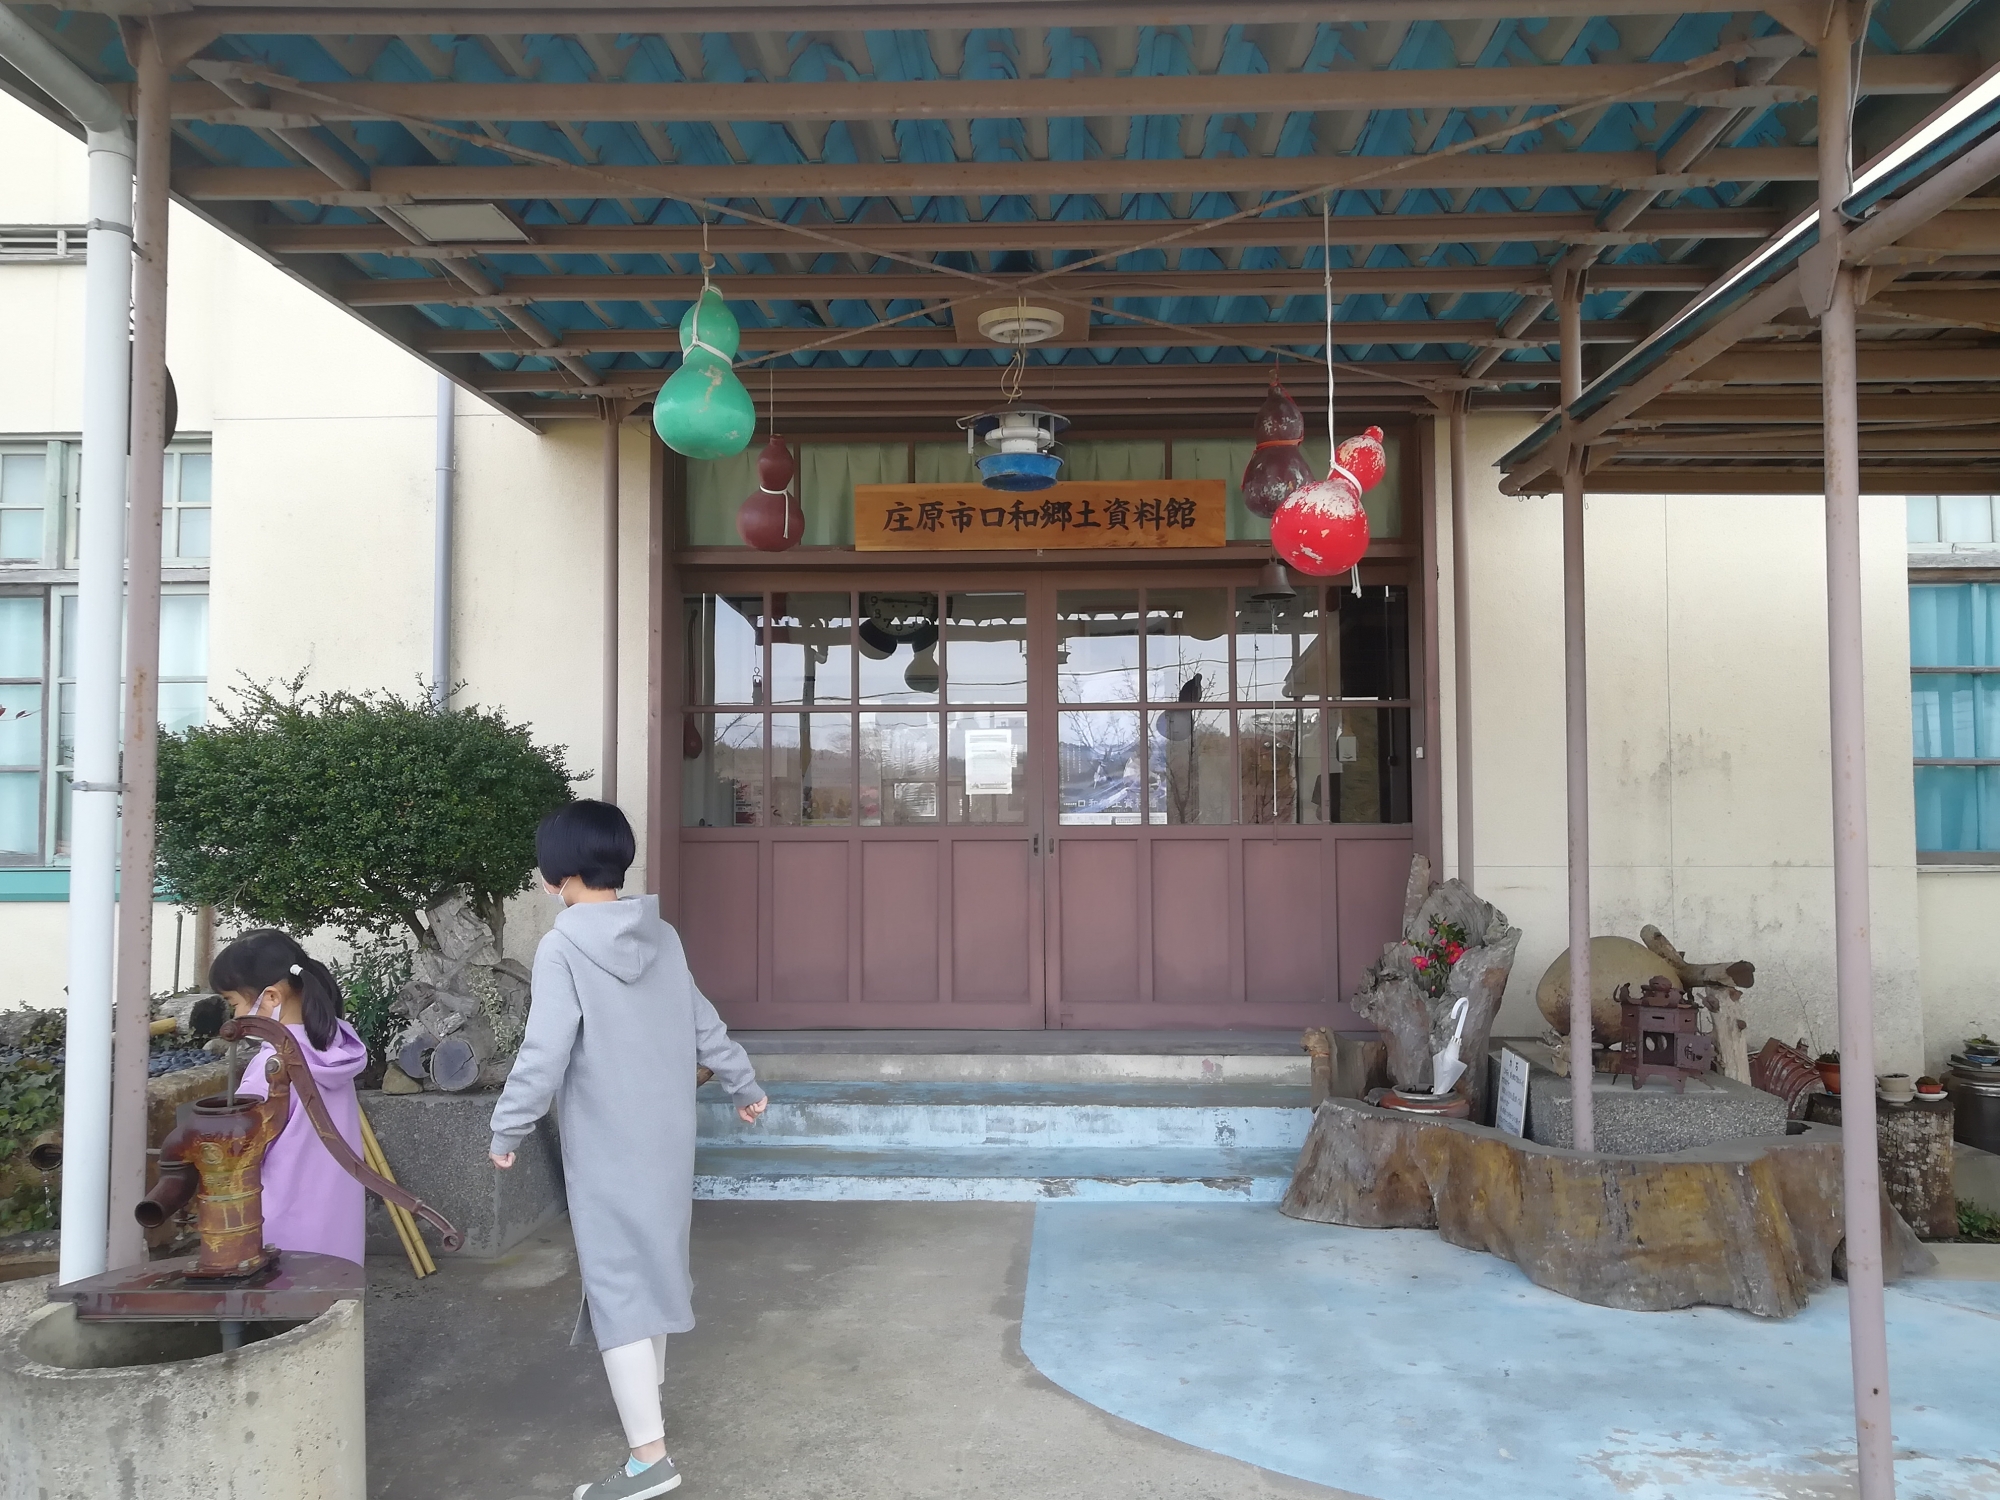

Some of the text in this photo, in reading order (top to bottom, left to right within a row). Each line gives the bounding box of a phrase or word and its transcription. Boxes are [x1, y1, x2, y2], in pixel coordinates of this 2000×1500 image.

[882, 497, 1198, 533] 庄原市口和郷土資料館
